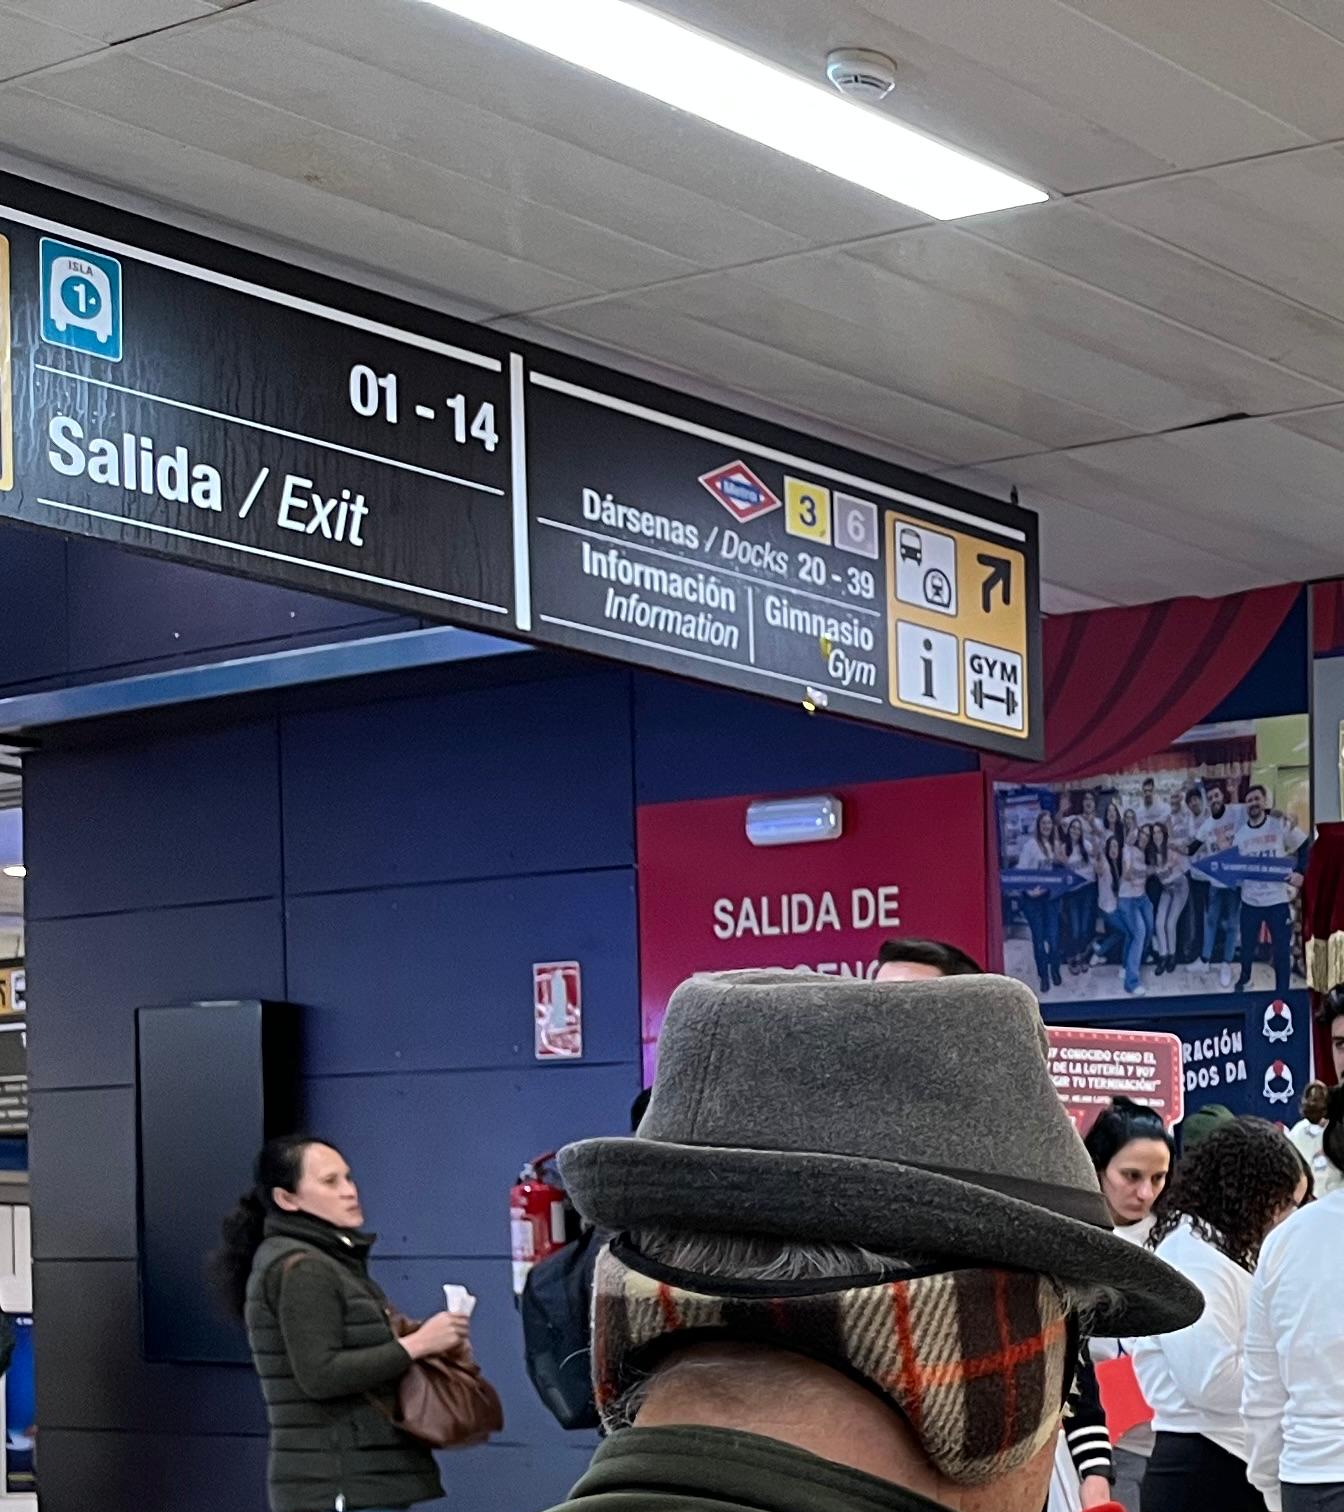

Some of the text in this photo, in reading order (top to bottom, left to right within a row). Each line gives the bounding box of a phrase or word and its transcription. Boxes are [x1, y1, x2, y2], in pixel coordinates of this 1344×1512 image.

[68, 260, 94, 276] ISLA
[349, 364, 398, 423] 01
[446, 394, 499, 452] 14
[48, 416, 222, 512] Salida
[277, 474, 369, 547] Exit
[799, 495, 817, 527] 3
[846, 509, 866, 543] 6
[582, 487, 699, 549] Dársenas
[721, 529, 789, 574] Docks
[797, 552, 827, 586] 20
[847, 566, 875, 599] 39
[582, 541, 736, 613] Información
[604, 587, 739, 650] Information
[764, 595, 874, 651] Gimnasio
[828, 648, 877, 687] Gym
[969, 653, 1018, 685] GYM
[713, 885, 900, 939] SALIDA DE
[1068, 1061, 1082, 1074] LA
[1072, 1076, 1086, 1088] TU
[1225, 1059, 1248, 1084] DA
